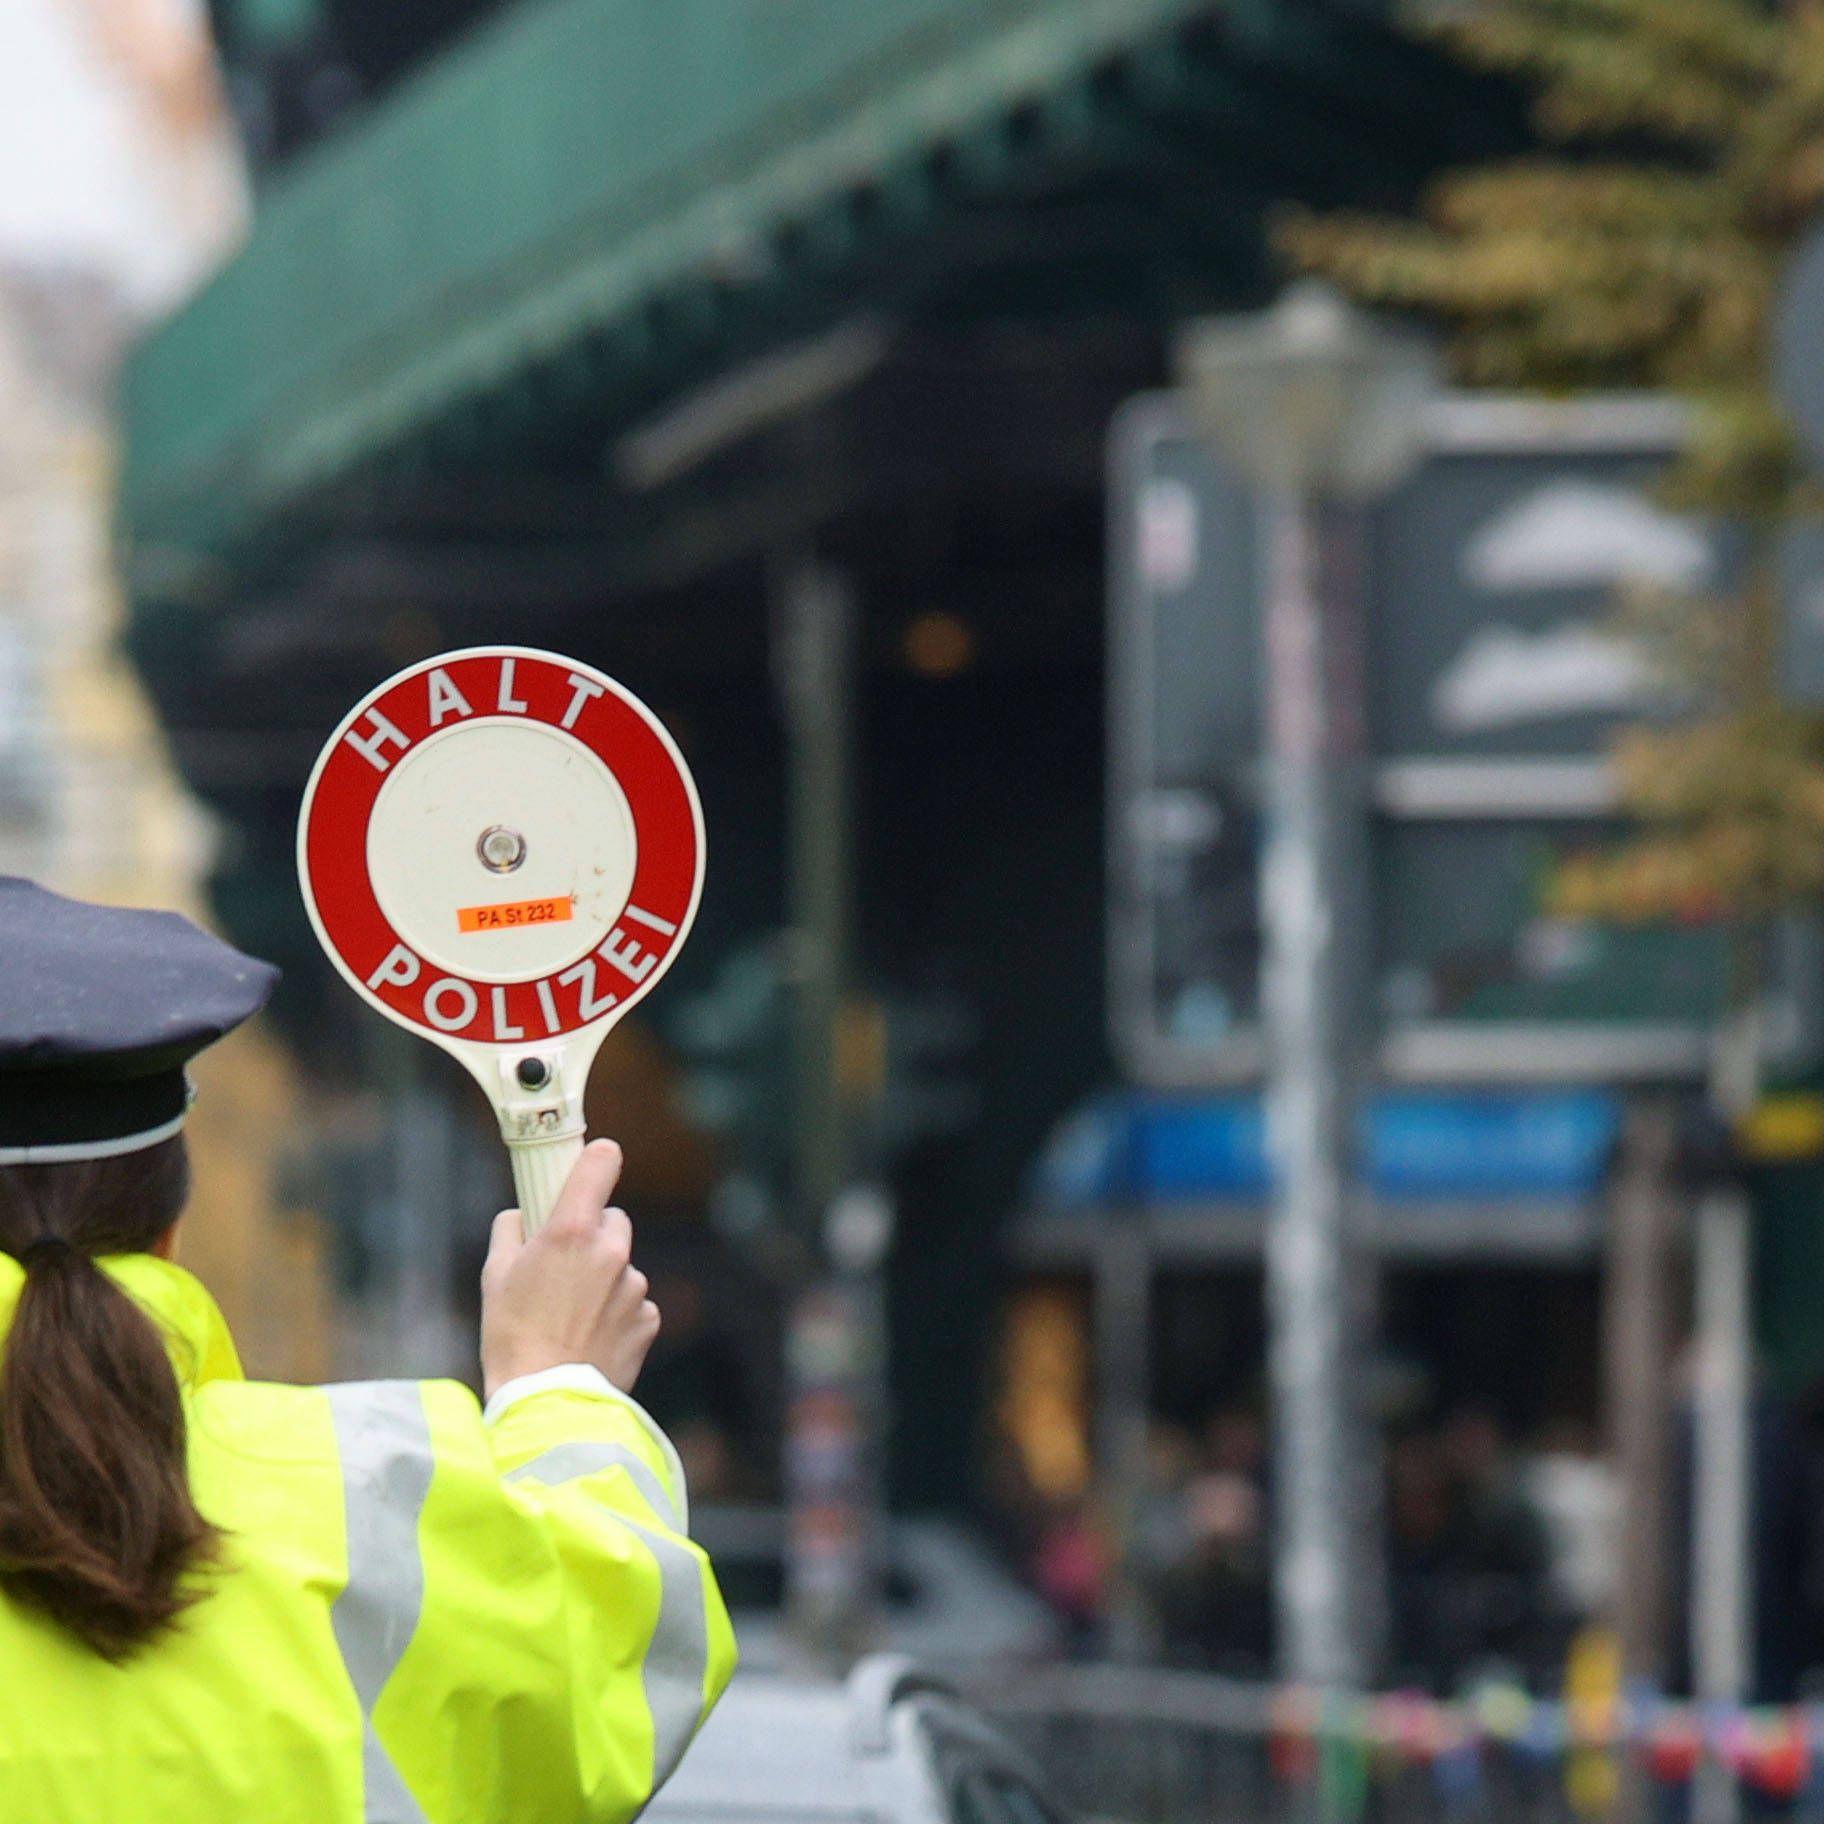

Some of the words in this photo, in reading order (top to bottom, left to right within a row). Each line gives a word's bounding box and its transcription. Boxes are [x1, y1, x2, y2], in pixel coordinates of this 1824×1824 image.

[343, 659, 605, 772] HALT
[366, 904, 677, 1040] POLIZEI
[477, 910, 501, 927] PA
